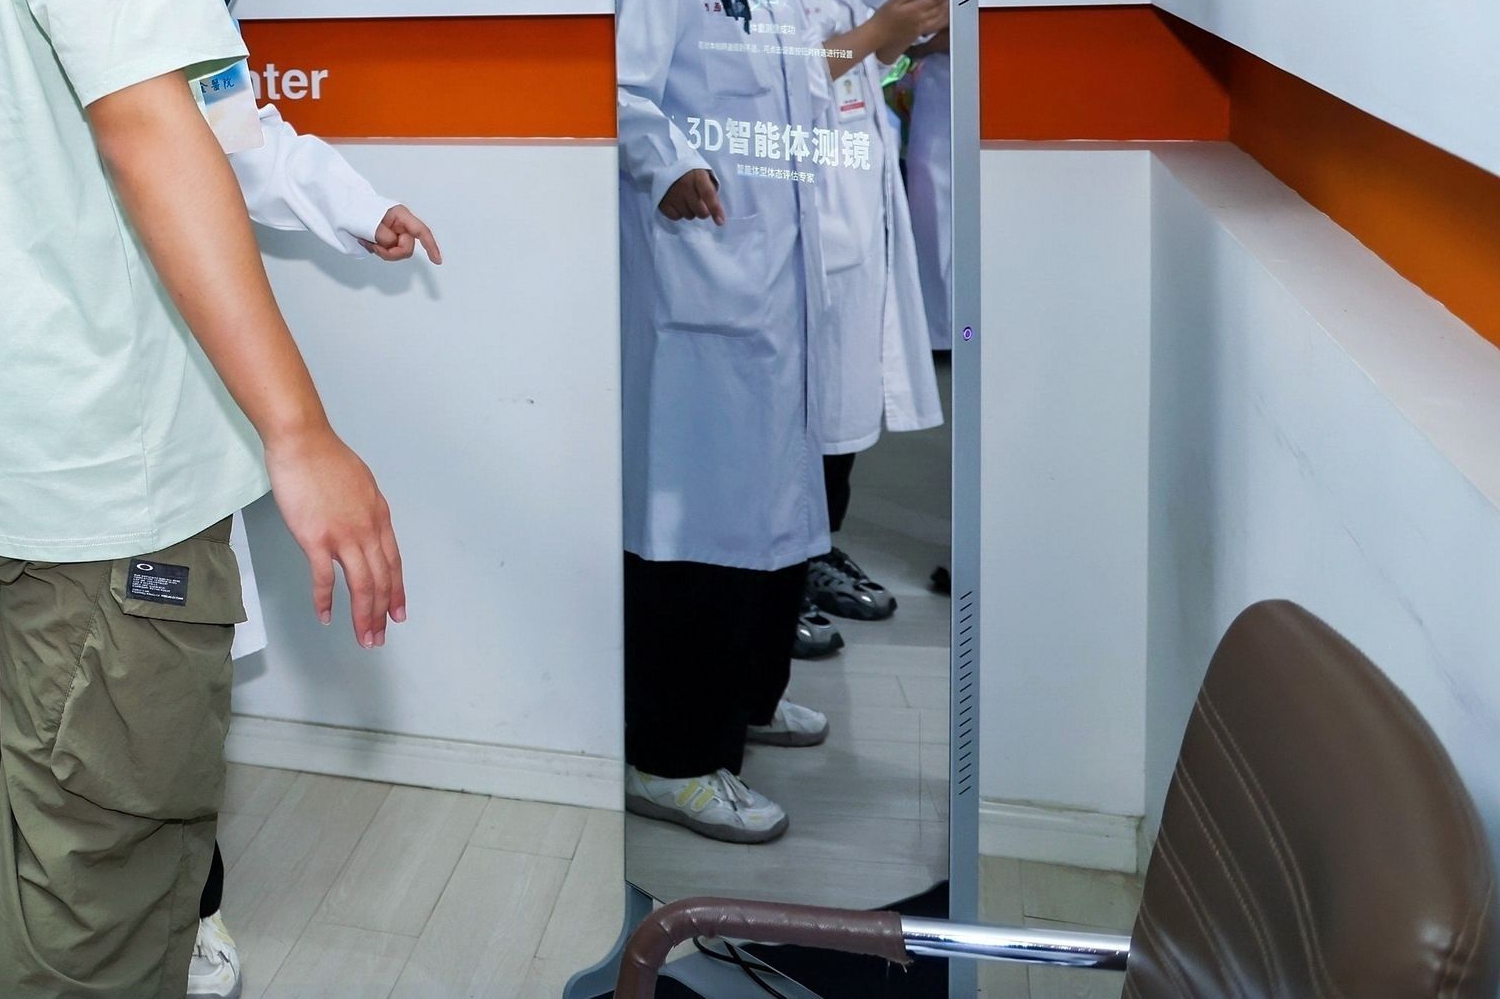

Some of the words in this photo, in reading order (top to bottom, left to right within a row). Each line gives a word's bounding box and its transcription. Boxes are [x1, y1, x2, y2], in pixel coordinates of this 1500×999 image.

[687, 117, 871, 170] 3D智能体测镜
